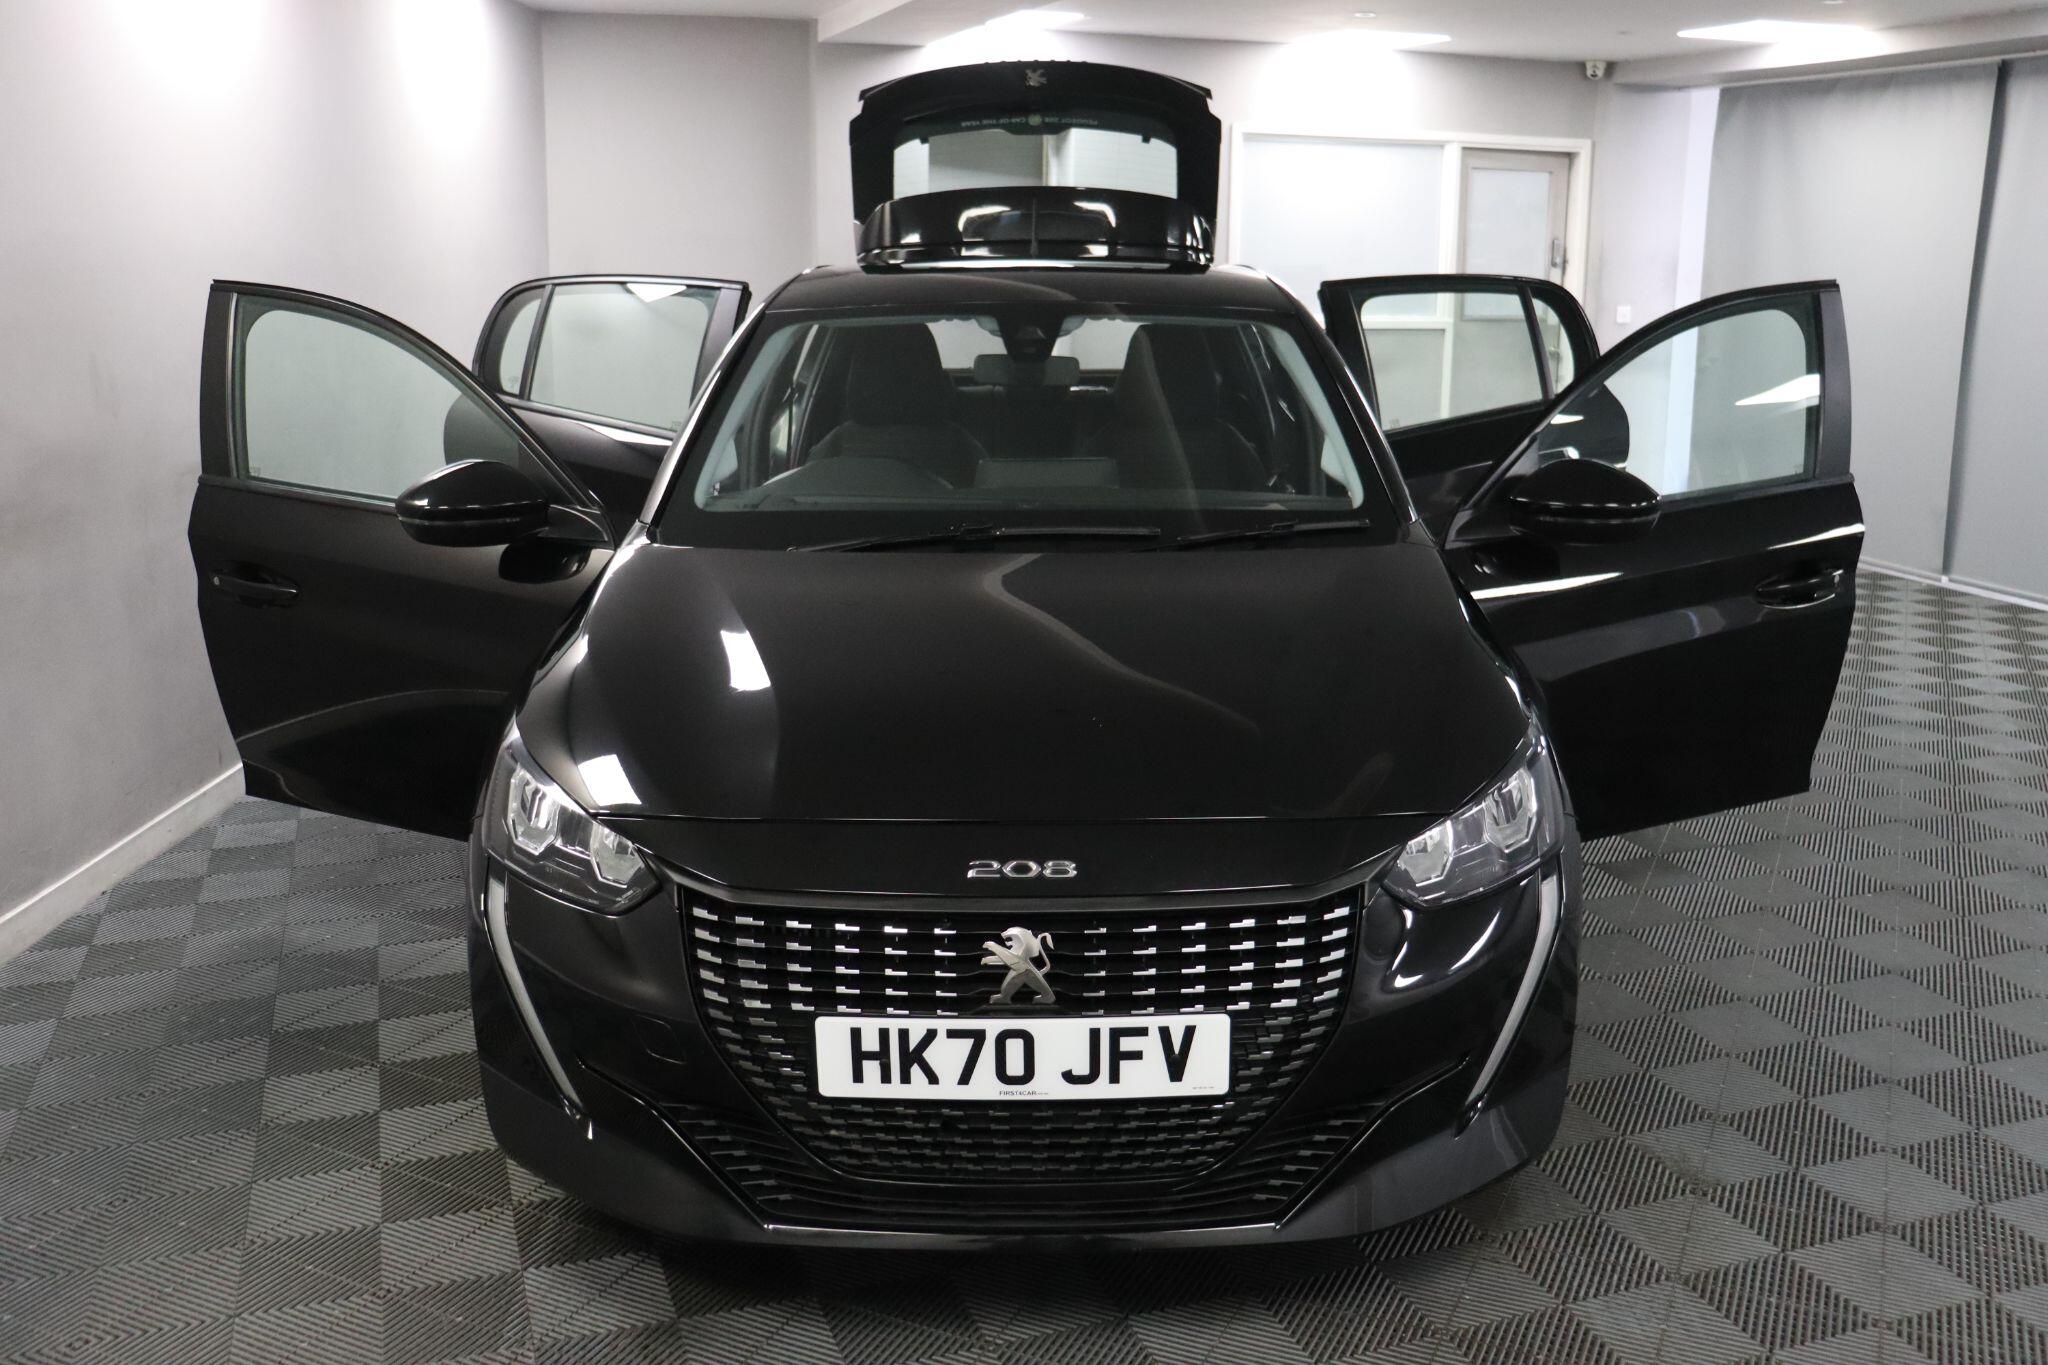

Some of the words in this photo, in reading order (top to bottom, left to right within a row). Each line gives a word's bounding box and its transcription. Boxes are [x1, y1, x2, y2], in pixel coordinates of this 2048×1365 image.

[967, 860, 1078, 878] 208
[849, 1026, 1036, 1086] HK70
[1060, 1024, 1197, 1085] JFV
